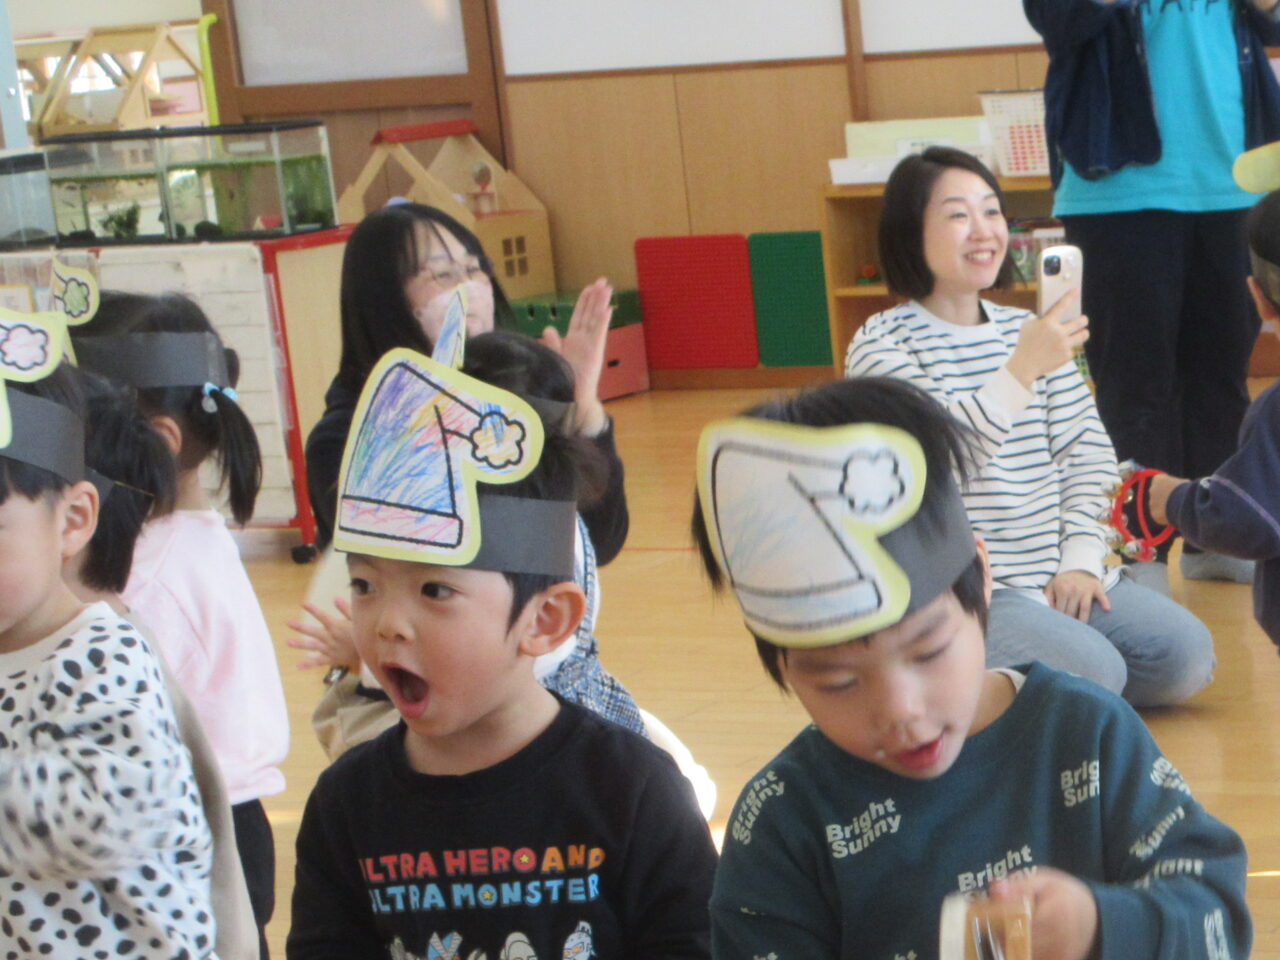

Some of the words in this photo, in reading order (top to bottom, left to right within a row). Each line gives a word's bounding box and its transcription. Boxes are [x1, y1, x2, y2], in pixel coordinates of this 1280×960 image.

[825, 797, 897, 843] Bright
[832, 814, 902, 859] Sunny
[359, 851, 437, 881] LTRA
[443, 846, 537, 875] HERO
[541, 844, 606, 872] AND
[958, 844, 1033, 893] Bright
[369, 883, 446, 913] LTRA
